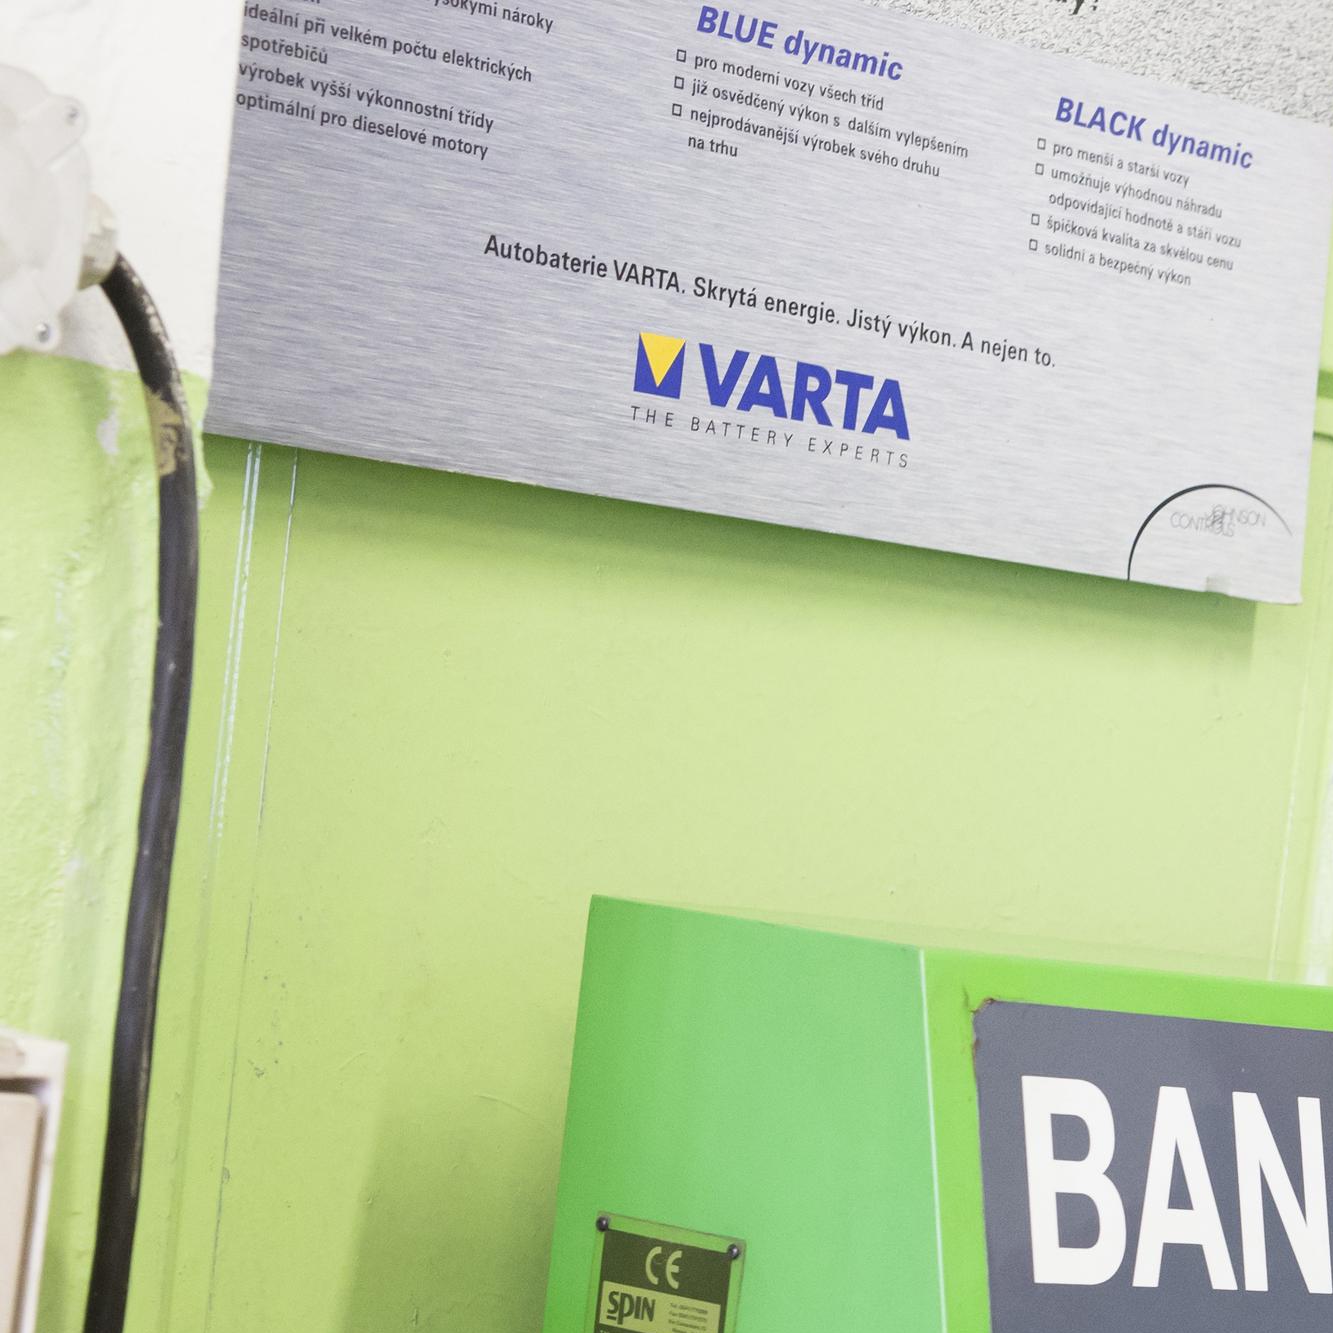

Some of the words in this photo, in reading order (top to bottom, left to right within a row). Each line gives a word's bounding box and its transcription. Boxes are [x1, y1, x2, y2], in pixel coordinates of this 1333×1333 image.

[241, 35, 328, 64] spotřebičů
[243, 2, 298, 28] ideální
[304, 18, 326, 34] při
[330, 25, 388, 48] velkém
[393, 41, 437, 60] počtu
[442, 49, 532, 82] elektrických
[502, 7, 554, 34] nároky
[696, 5, 778, 50] BLUE
[784, 29, 904, 81] dynamic
[239, 63, 305, 89] výrobek
[310, 79, 351, 99] vyšší
[356, 88, 454, 122] výkonnostní
[458, 109, 494, 134] třídy
[694, 55, 718, 70] pro
[722, 61, 780, 86] moderní
[784, 76, 815, 97] vozy
[820, 84, 857, 104] všech
[861, 92, 885, 111] tříd
[236, 92, 316, 121] optimální
[319, 109, 347, 128] pro
[351, 114, 427, 145] dieselové
[432, 135, 489, 161] motory
[687, 136, 705, 150] na
[709, 138, 739, 158] trhu
[690, 108, 799, 145] nejprodávanější
[803, 132, 856, 158] výrobek
[860, 149, 899, 168] svého
[902, 157, 940, 177] druhu
[692, 78, 708, 96] již
[712, 86, 785, 117] osvědčený
[789, 103, 829, 125] výkon
[833, 116, 841, 128] s
[848, 117, 891, 139] dalším
[896, 130, 969, 159] vylepšením
[1055, 96, 1148, 142] BLACK
[1152, 123, 1253, 169] dynamic
[1050, 166, 1111, 194] umožňuje
[1114, 181, 1173, 206] výhodnou
[1175, 194, 1223, 219] náhradu
[1053, 142, 1073, 157] pro
[1076, 147, 1114, 168] menší
[1116, 157, 1124, 170] a
[1127, 159, 1160, 179] starší
[1163, 169, 1190, 189] vozy
[1046, 215, 1098, 240] špičková
[1101, 227, 1140, 249] kvalita
[1143, 239, 1157, 253] za
[1206, 256, 1234, 271] cenu
[1048, 192, 1122, 220] odpovídající
[1124, 207, 1173, 232] hodnotě
[1176, 222, 1183, 235] a
[1215, 233, 1242, 248] vozu
[1044, 240, 1085, 262] solidní
[1088, 253, 1096, 265] a
[1098, 251, 1154, 280] bezpečný
[1157, 268, 1192, 287] výkon
[483, 234, 608, 279] Autobaterie
[613, 259, 686, 294] VARTA.
[692, 276, 757, 309] Skrytá
[764, 295, 840, 325] energie.
[847, 308, 892, 338] Jistý
[898, 320, 956, 348] výkon.
[961, 331, 974, 351] A
[980, 338, 1028, 363] nejen
[1034, 347, 1056, 368] to.
[699, 342, 911, 441] VARTA
[631, 405, 675, 428] THE
[690, 416, 794, 448] BATTERY
[807, 437, 908, 469] EXPERTS
